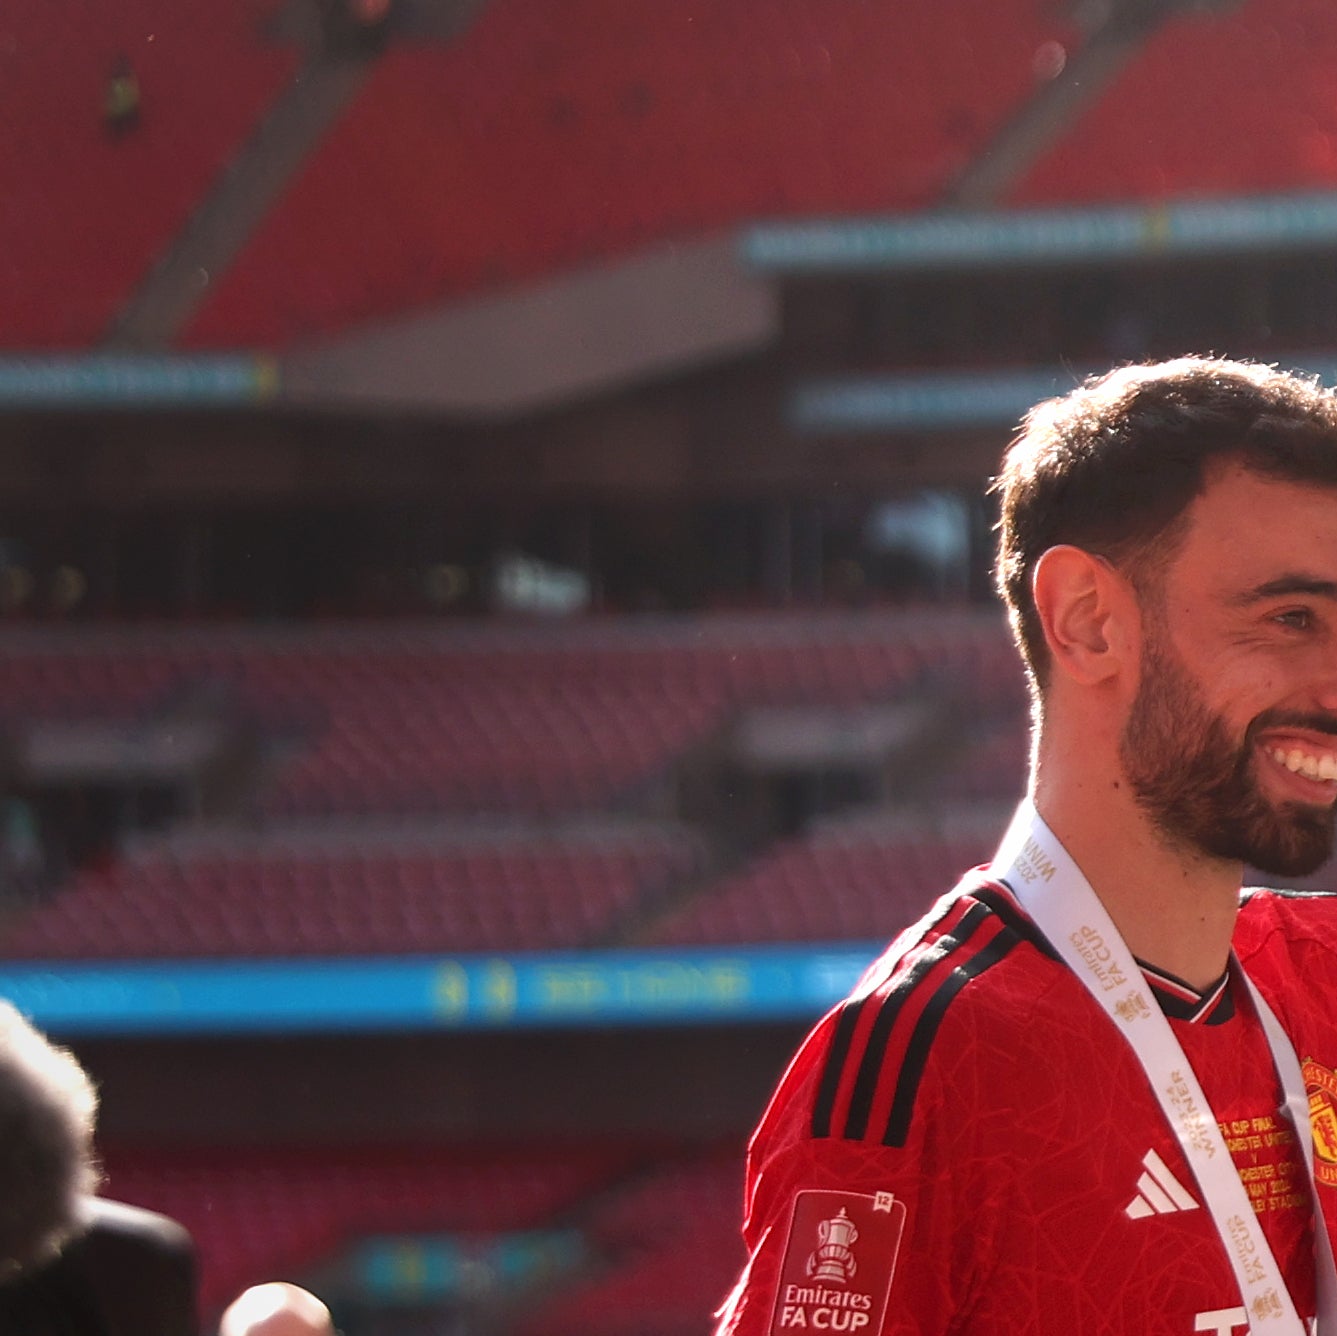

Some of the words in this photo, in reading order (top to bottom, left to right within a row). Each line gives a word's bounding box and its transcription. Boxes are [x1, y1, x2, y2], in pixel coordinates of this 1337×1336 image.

[1081, 925, 1111, 962] CUP
[1107, 962, 1127, 987] FA
[1171, 1069, 1216, 1159] WINNER
[1233, 1214, 1257, 1259] CUP
[1248, 1259, 1268, 1286] FA
[785, 1284, 872, 1310] Emirates
[780, 1306, 807, 1328] FA
[812, 1307, 870, 1332] CUP
